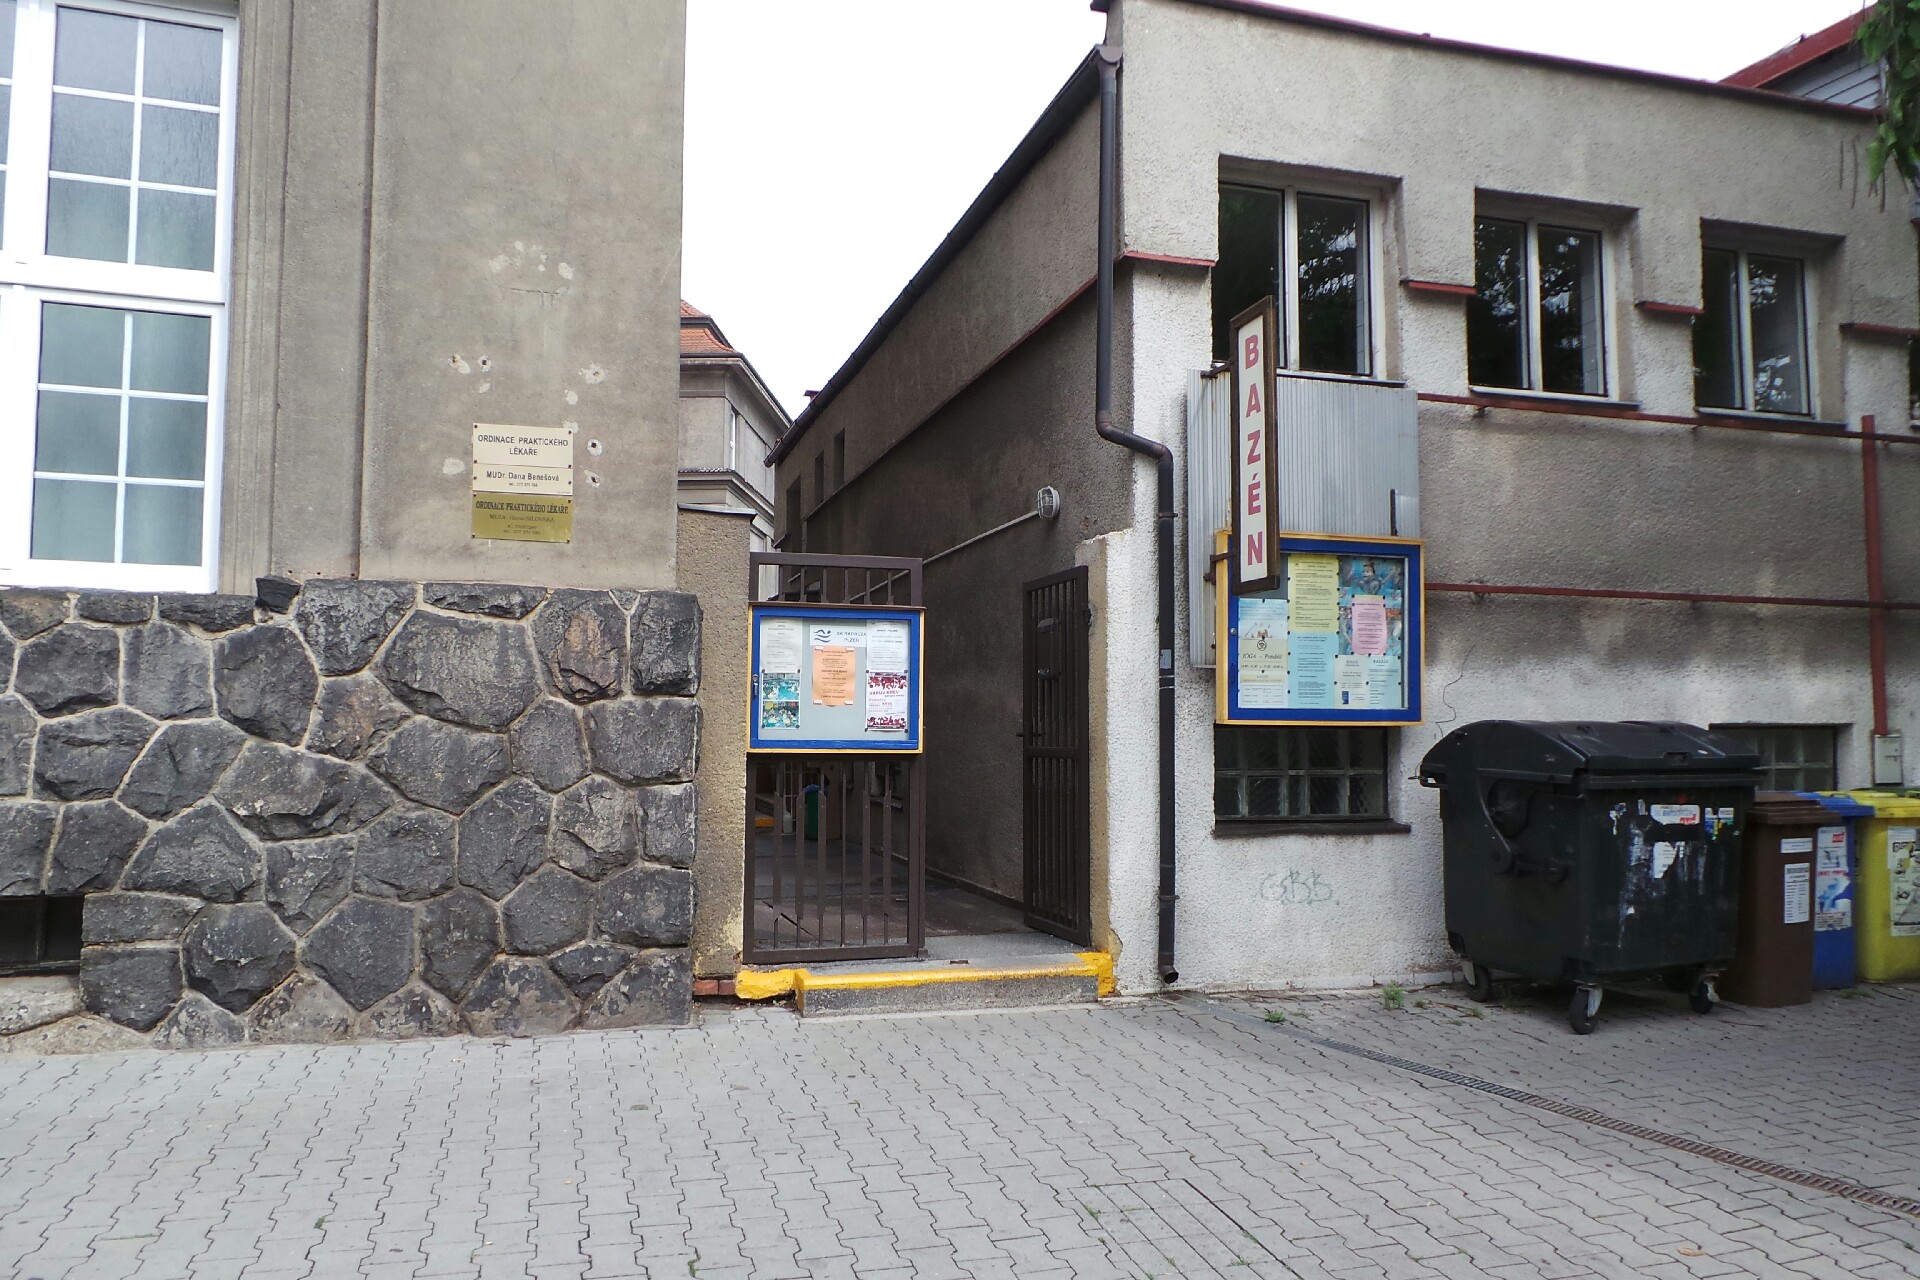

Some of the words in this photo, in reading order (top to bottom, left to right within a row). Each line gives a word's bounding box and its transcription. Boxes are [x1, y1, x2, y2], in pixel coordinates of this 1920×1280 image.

[477, 434, 516, 444] ORDINACE
[518, 436, 569, 447] PRAKTICKÉHO
[509, 447, 538, 456] LÉKAŘE
[1244, 334, 1263, 566] BAZÉN
[486, 470, 507, 479] MUDr.
[508, 471, 526, 480] Dana
[527, 472, 560, 482] Benešová
[475, 500, 505, 511] ORDINACE
[505, 502, 546, 514] PRAKTICKÉHO
[546, 503, 569, 515] LÉKAŘE
